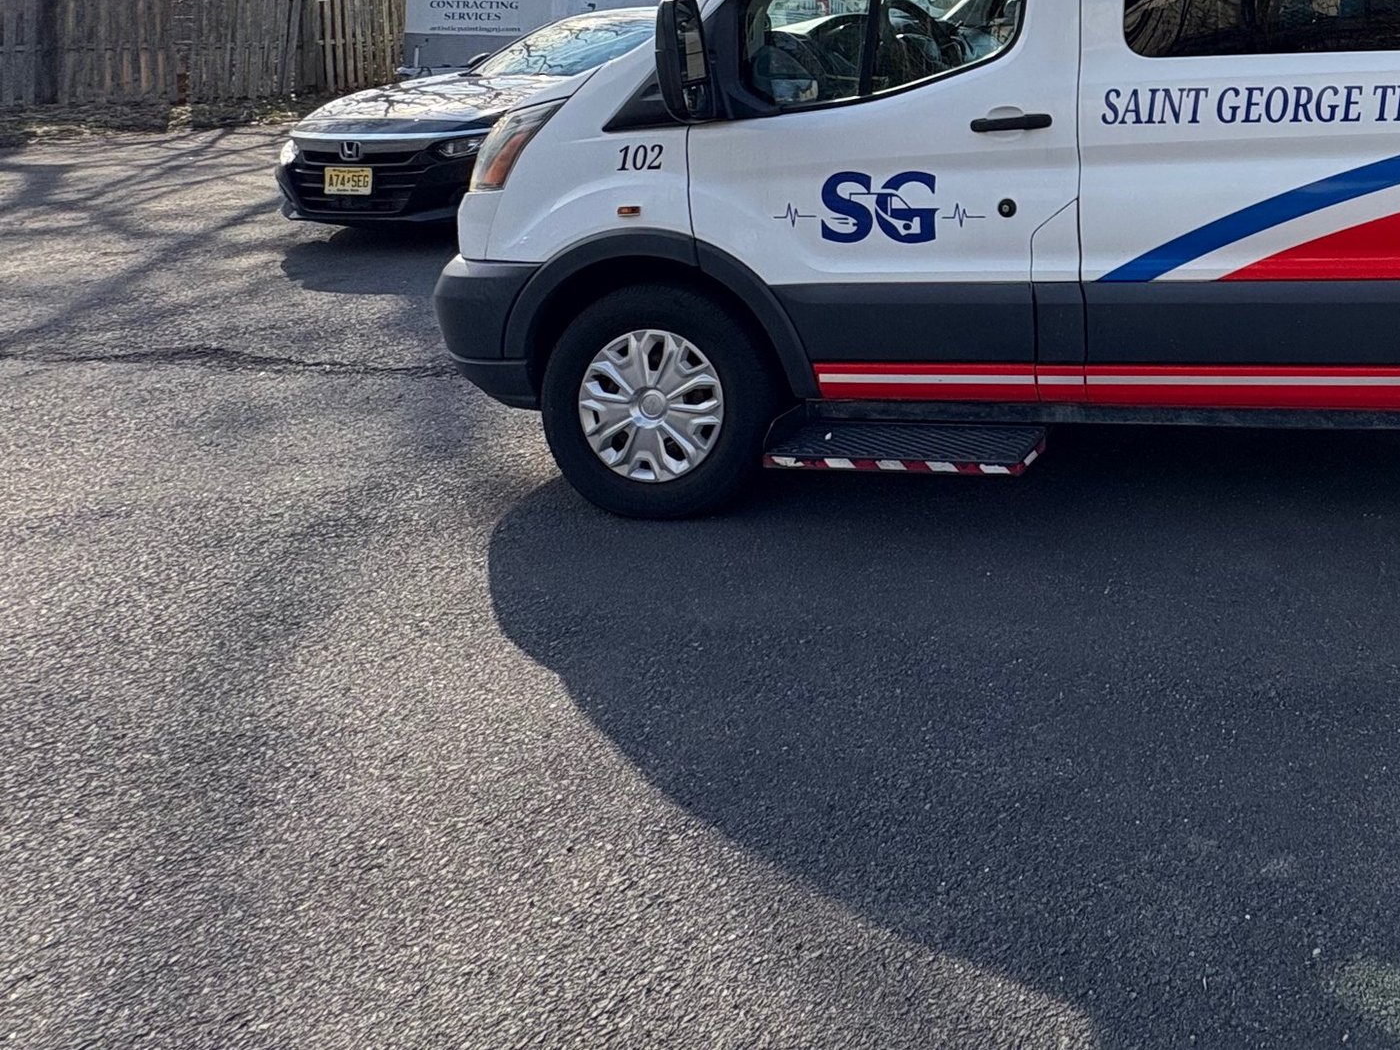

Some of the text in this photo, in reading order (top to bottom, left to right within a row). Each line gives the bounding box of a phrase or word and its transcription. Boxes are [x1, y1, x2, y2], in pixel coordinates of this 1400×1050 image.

[429, 0, 519, 10] CONTRACTING
[444, 12, 502, 21] SERVICES
[1101, 87, 1209, 125] SAINT
[1216, 85, 1363, 123] GEORGE
[616, 143, 664, 172] 102
[820, 170, 937, 244] SG
